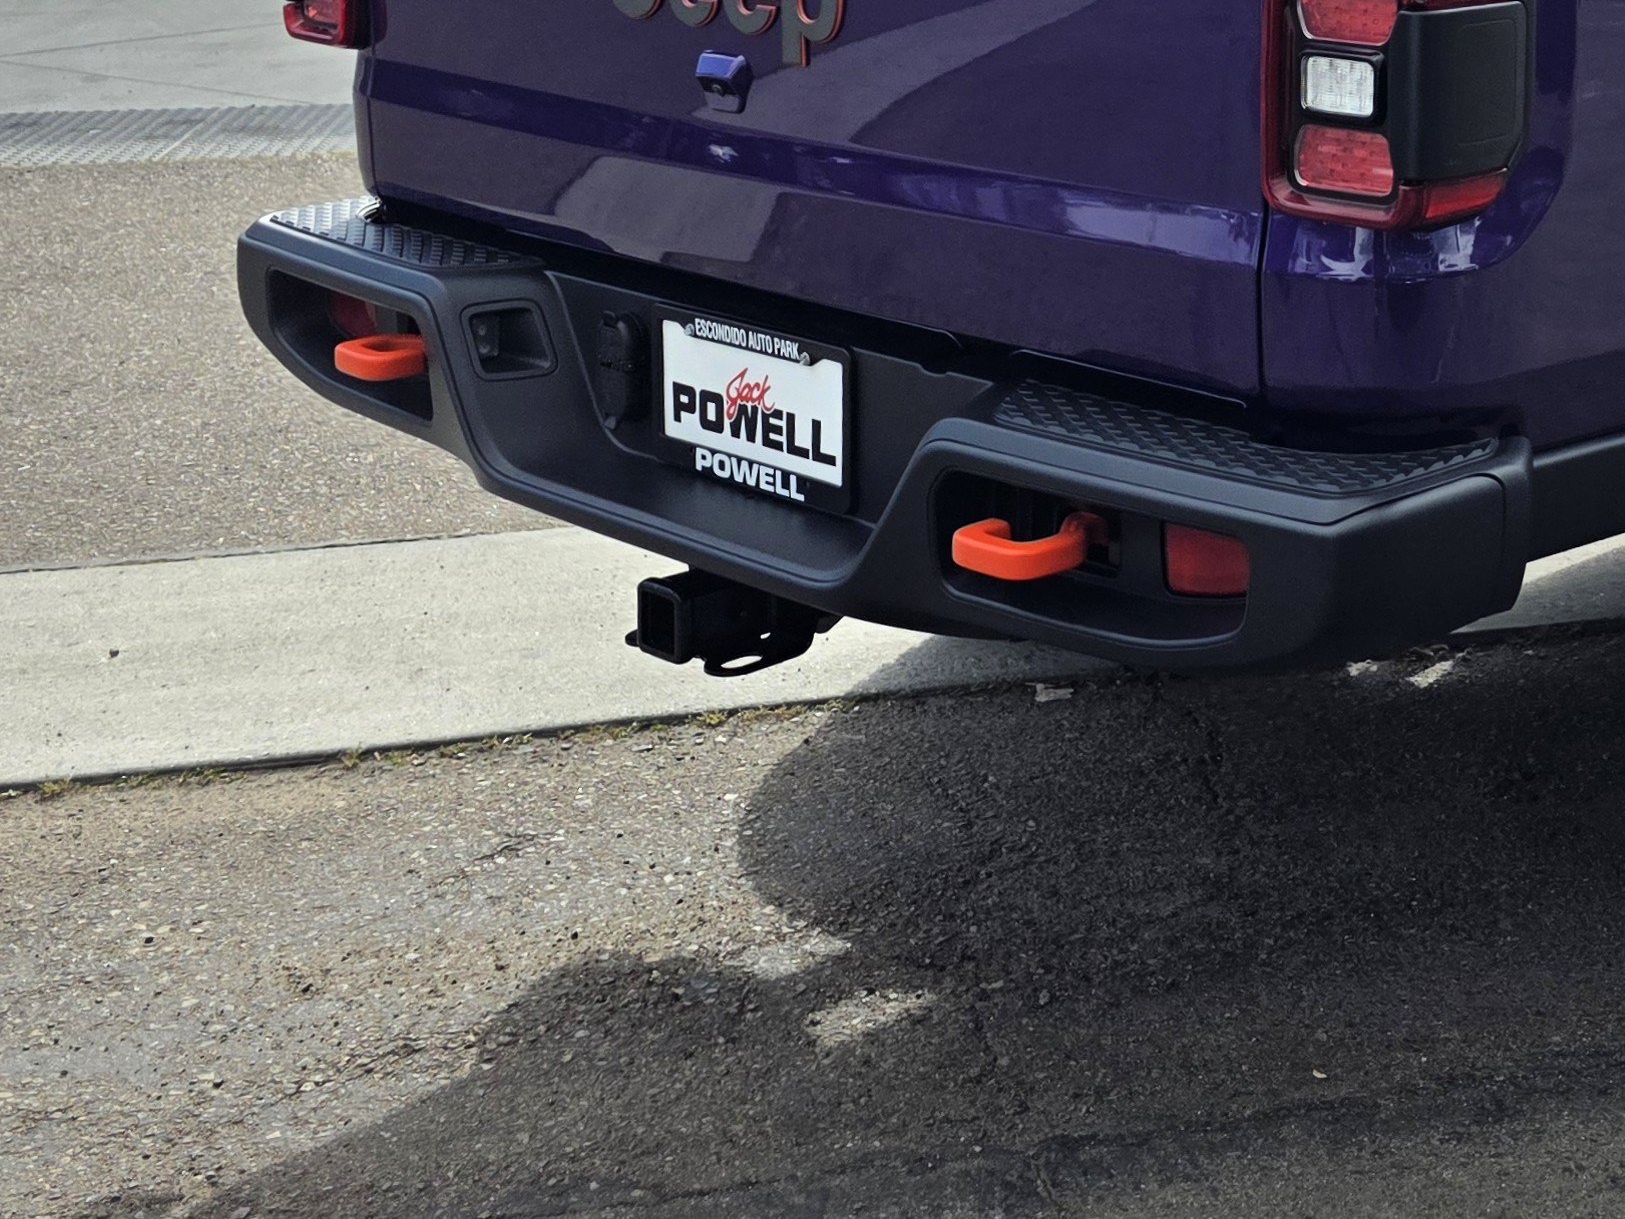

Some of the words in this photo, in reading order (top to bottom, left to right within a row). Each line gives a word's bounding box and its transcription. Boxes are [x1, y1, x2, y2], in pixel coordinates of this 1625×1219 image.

[695, 318, 747, 347] ESCONDIDO
[748, 330, 773, 354] AUTO
[773, 337, 800, 360] PARK
[726, 367, 776, 420] Jack
[672, 381, 837, 467] POWELL
[695, 447, 805, 502] POWELL
